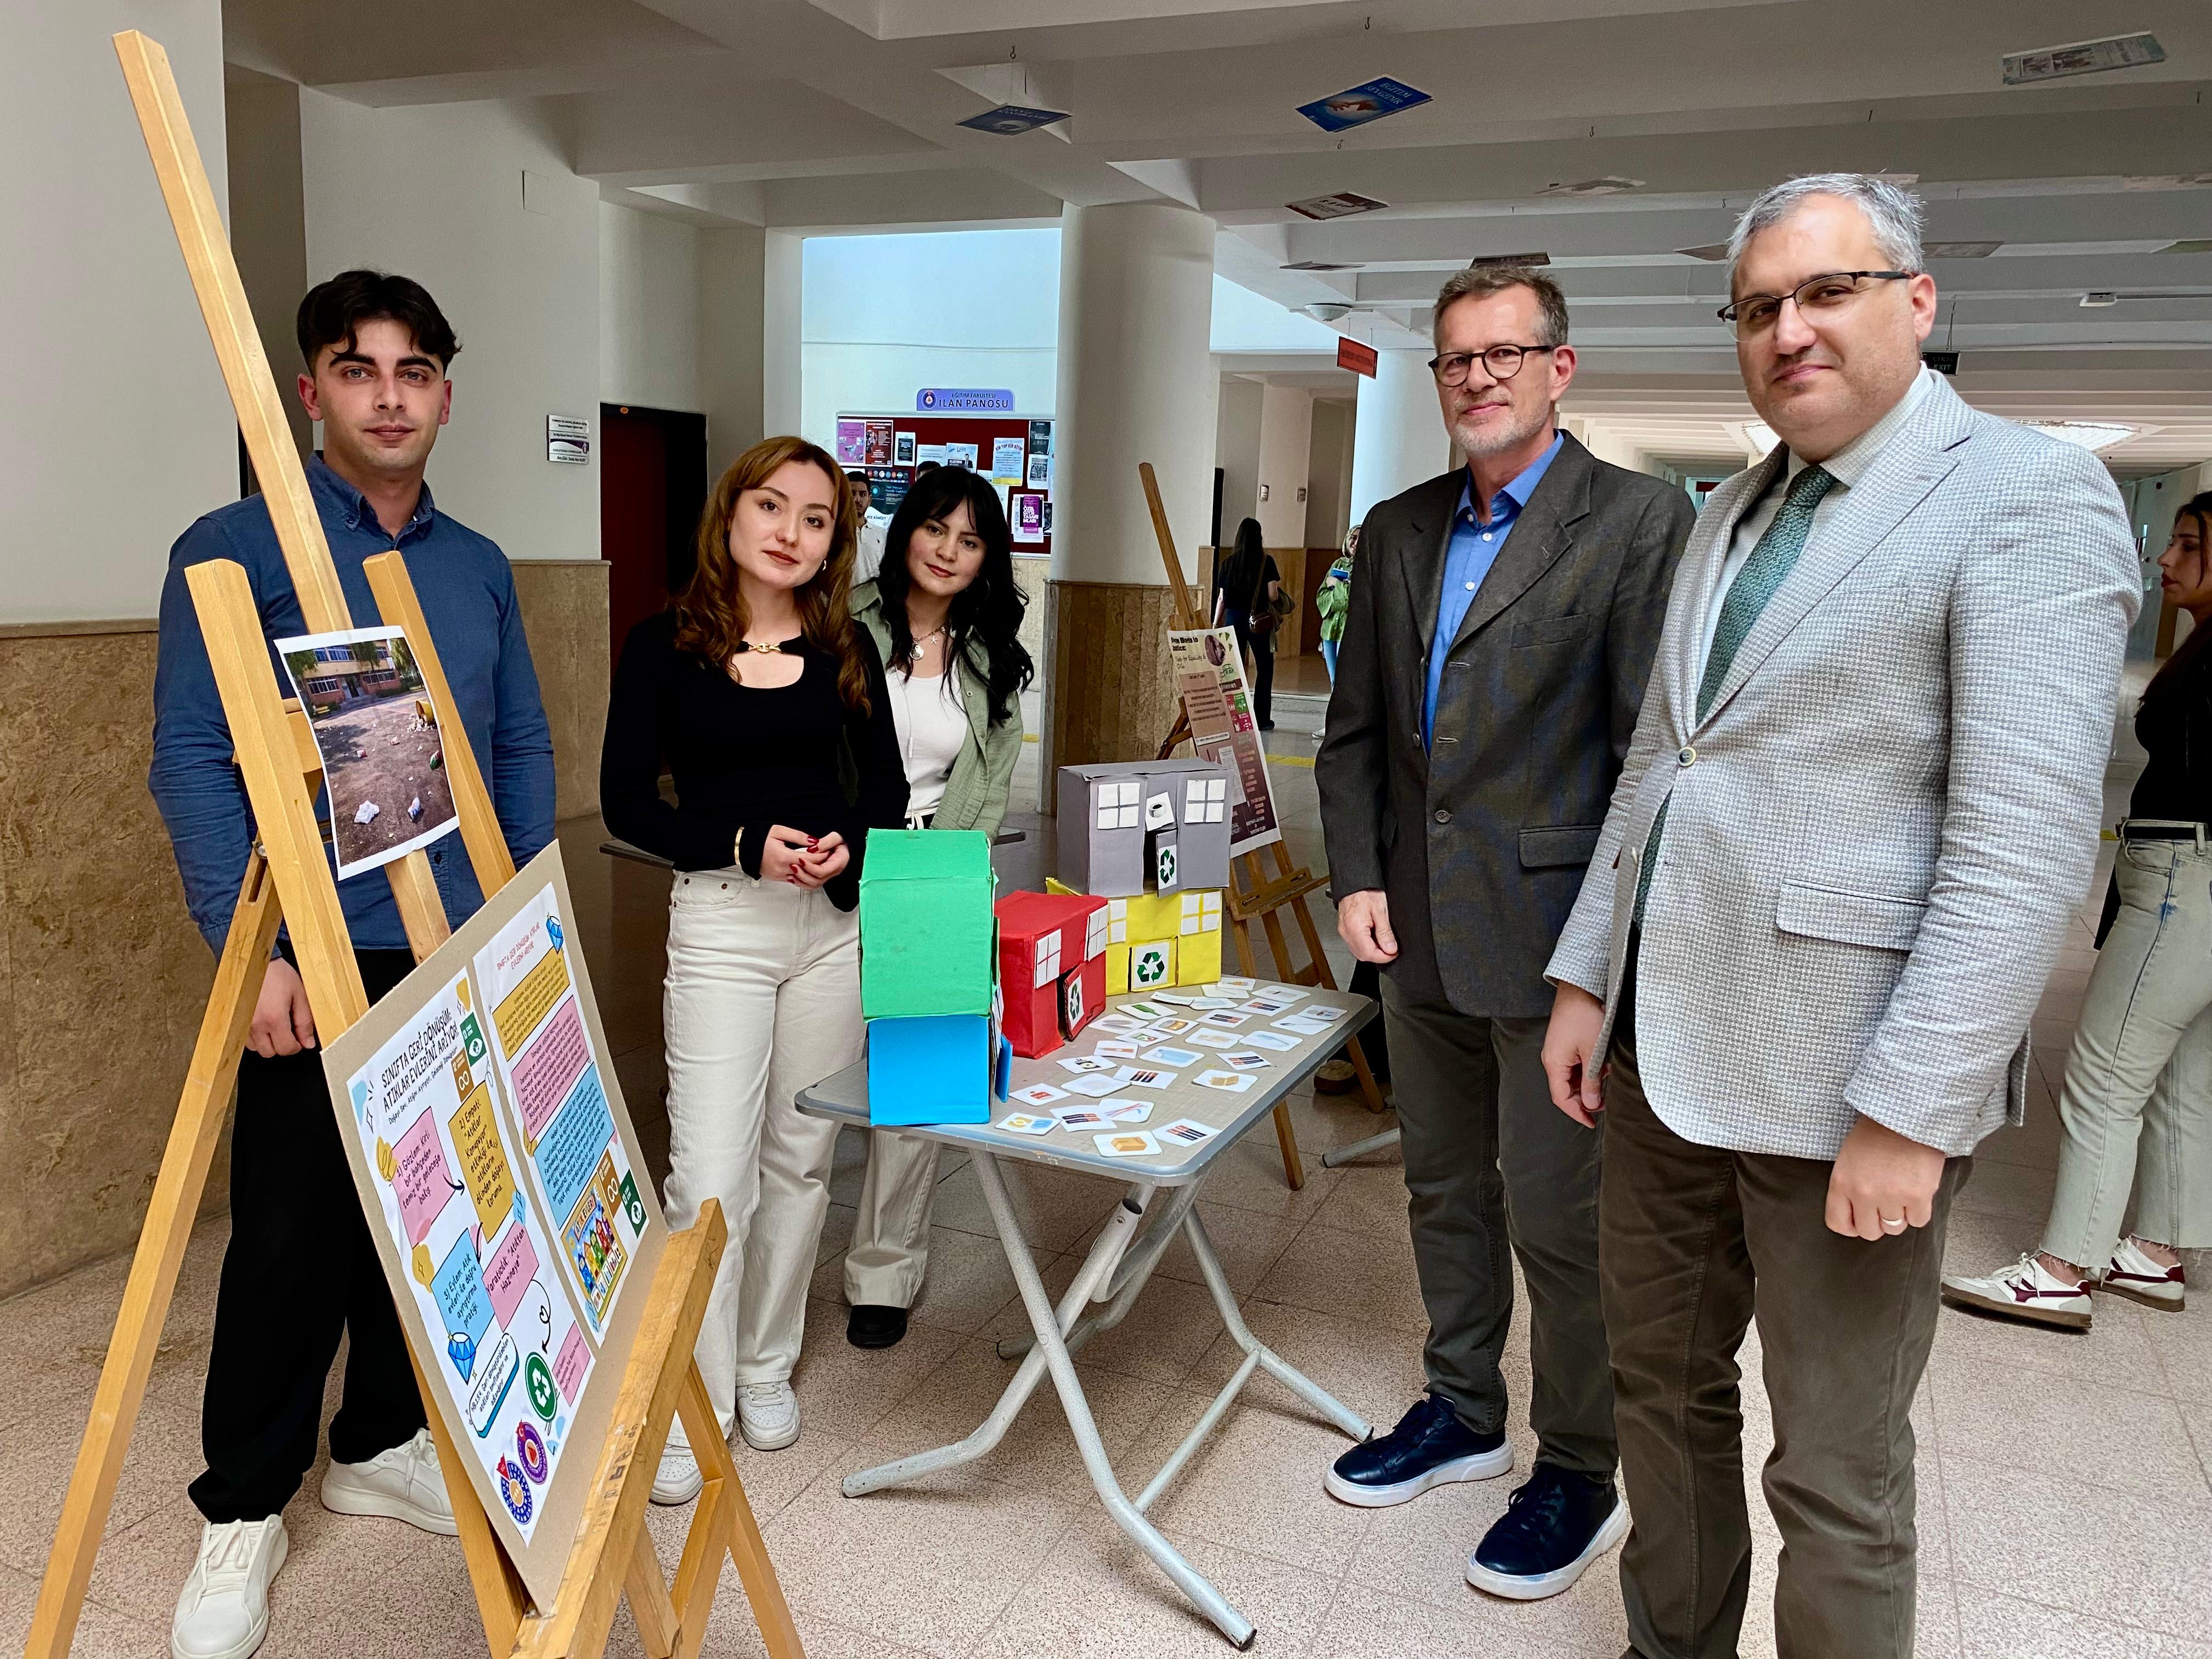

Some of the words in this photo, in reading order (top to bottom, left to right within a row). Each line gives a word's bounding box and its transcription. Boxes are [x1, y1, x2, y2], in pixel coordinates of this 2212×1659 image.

[939, 397, 962, 407] İLAN
[966, 399, 1008, 408] PANOSU
[382, 1052, 409, 1088] SINIFTA
[408, 1031, 424, 1060] GERİ
[424, 1008, 452, 1046] DÖNÜŞÜM:
[383, 1074, 410, 1113] ATIKLAR
[411, 1041, 438, 1084] EVLERİNİ
[388, 1109, 400, 1125] Doğayı
[459, 1116, 465, 1130] 2)
[402, 1144, 421, 1171] Gözlem:
[411, 1148, 431, 1177] bahçeden
[403, 1188, 417, 1209] temiz
[422, 1154, 441, 1183] geleceğe
[443, 1286, 451, 1300] 3)
